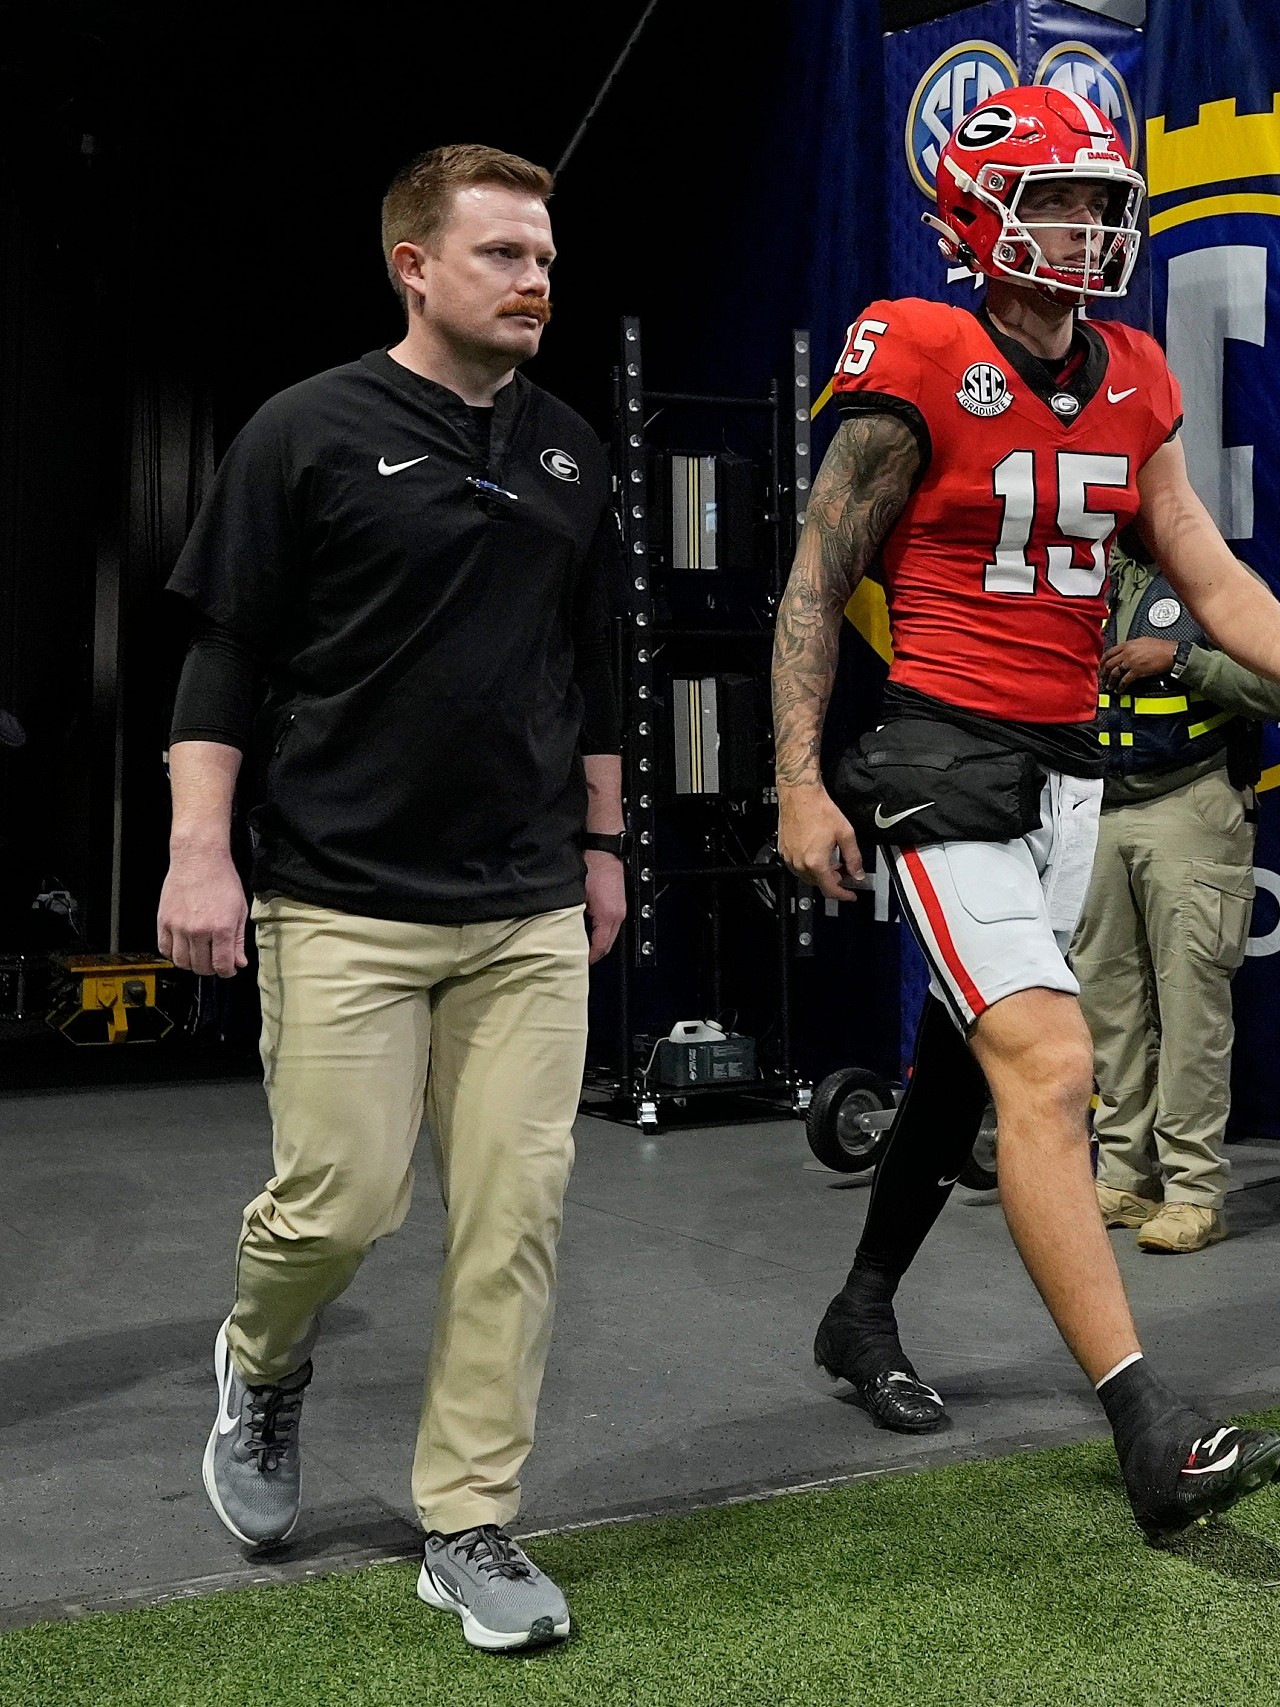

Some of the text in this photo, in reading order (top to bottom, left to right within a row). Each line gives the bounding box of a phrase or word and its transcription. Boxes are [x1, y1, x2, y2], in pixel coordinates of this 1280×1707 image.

[966, 365, 1003, 403] SEC
[961, 399, 1008, 417] GRADUATE
[984, 449, 1129, 597] 15
